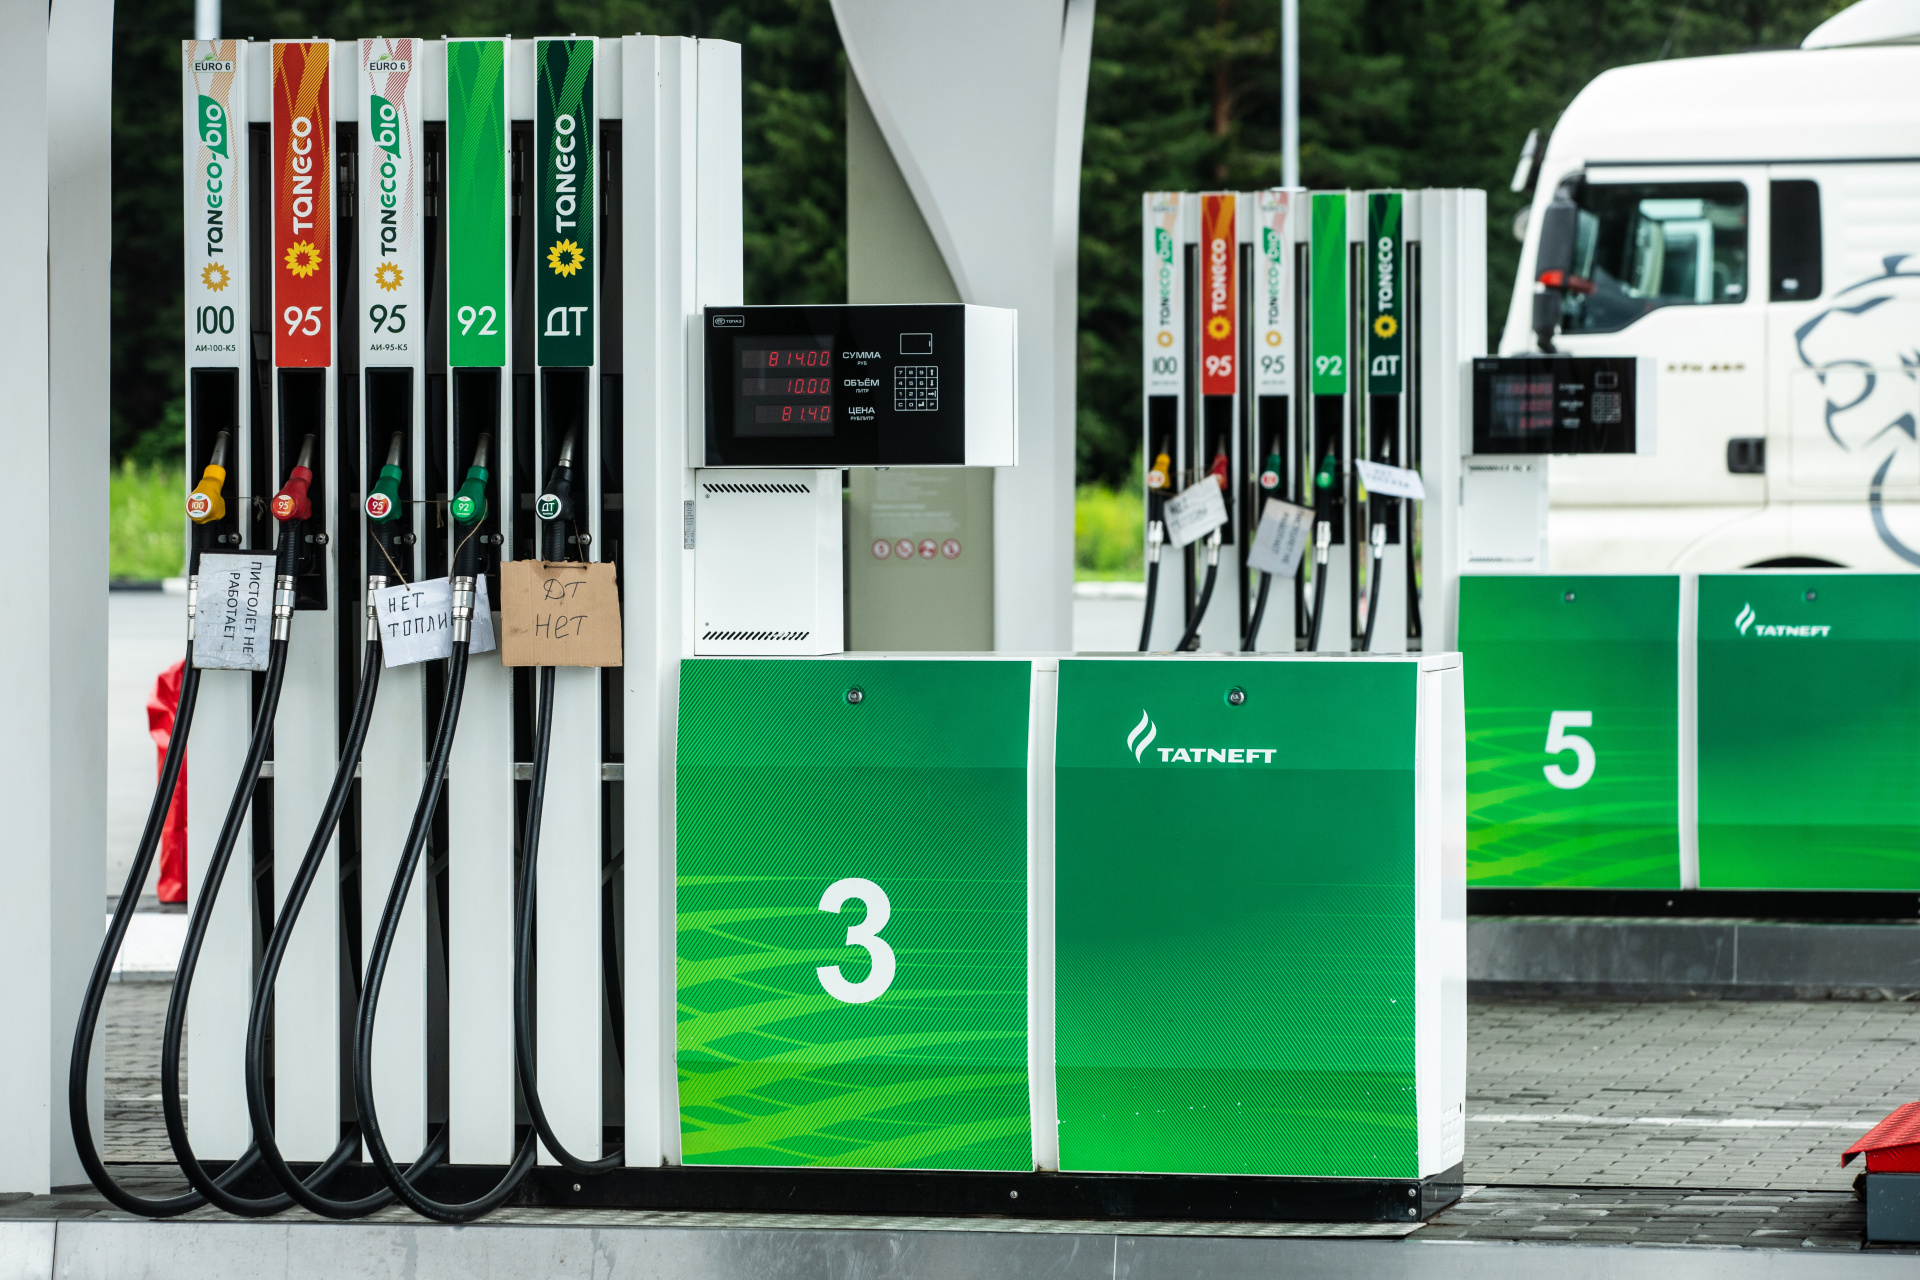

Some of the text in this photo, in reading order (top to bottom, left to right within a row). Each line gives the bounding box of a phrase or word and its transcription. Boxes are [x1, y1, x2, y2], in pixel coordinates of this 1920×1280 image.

[195, 62, 231, 71] EURO 6
[370, 62, 406, 71] EURO 6
[196, 305, 235, 335] 100
[283, 306, 323, 336] 95
[369, 304, 408, 334] 95
[457, 305, 498, 336] 92
[544, 306, 589, 337] ДТ
[768, 351, 830, 367] 814.00
[842, 351, 882, 359] СУММА
[1152, 356, 1178, 375] 100
[1206, 355, 1232, 377] 95
[1260, 355, 1285, 375] 95
[1315, 356, 1343, 376] 92
[1371, 355, 1400, 376] ДТ
[788, 378, 830, 394] 10.00
[844, 378, 880, 387] ОБЪЁМ
[782, 406, 830, 422] 81.40
[848, 406, 876, 415] ЦЕНА
[191, 502, 205, 510] 100
[278, 502, 290, 510] 95
[372, 501, 384, 510] 95
[458, 503, 469, 512] 92
[542, 502, 555, 512] ДТ
[543, 578, 587, 600] ДТ
[224, 572, 241, 641] РАБОТАЕТ
[242, 562, 262, 654] ПИСТОЛЕТ НЕ
[388, 592, 424, 613] НЕТ
[388, 610, 454, 638] ТОПЛИ
[1755, 625, 1831, 637] TATNEFT
[1158, 747, 1277, 763] TATNEFT
[1543, 710, 1596, 790] 5
[816, 877, 896, 1004] 3
